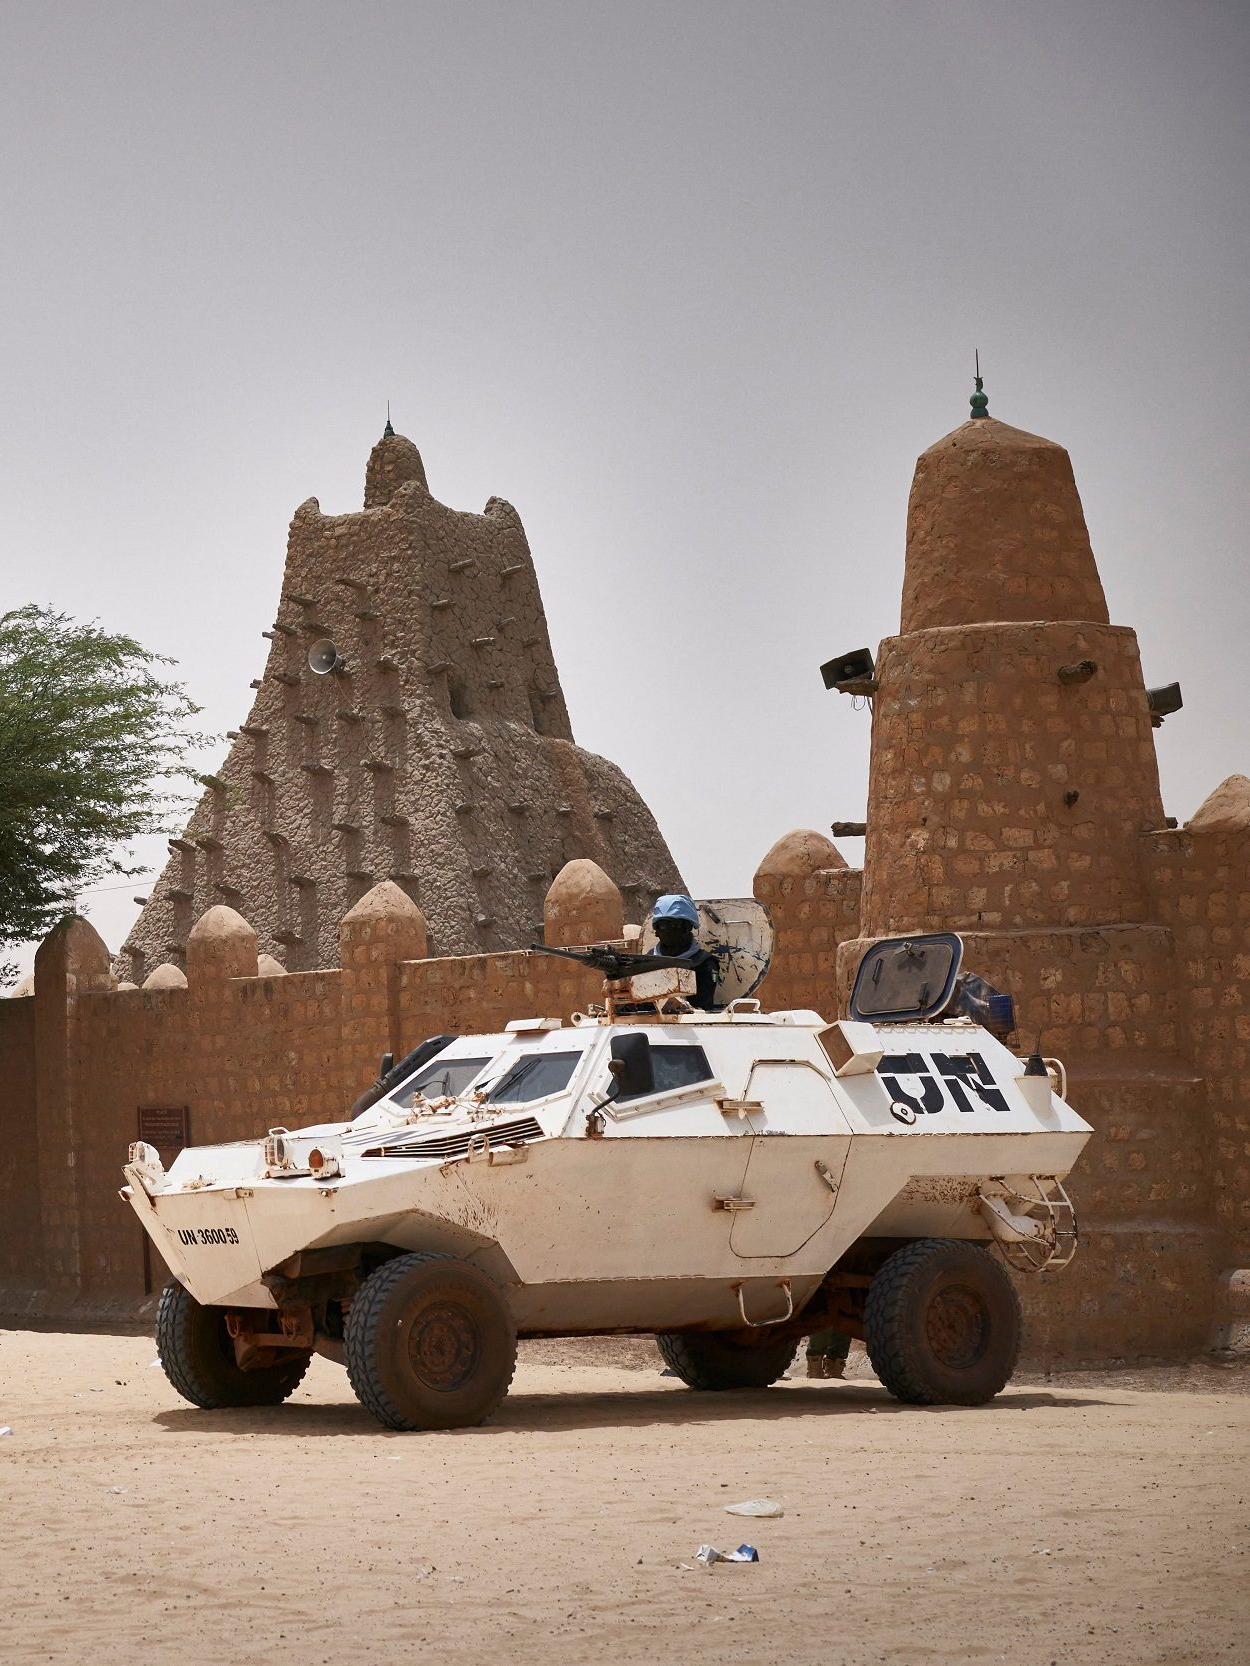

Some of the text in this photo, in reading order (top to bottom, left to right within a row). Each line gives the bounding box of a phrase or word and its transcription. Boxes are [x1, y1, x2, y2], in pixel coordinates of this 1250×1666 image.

[875, 1052, 1011, 1115] UN
[177, 1227, 239, 1246] UN 360059
